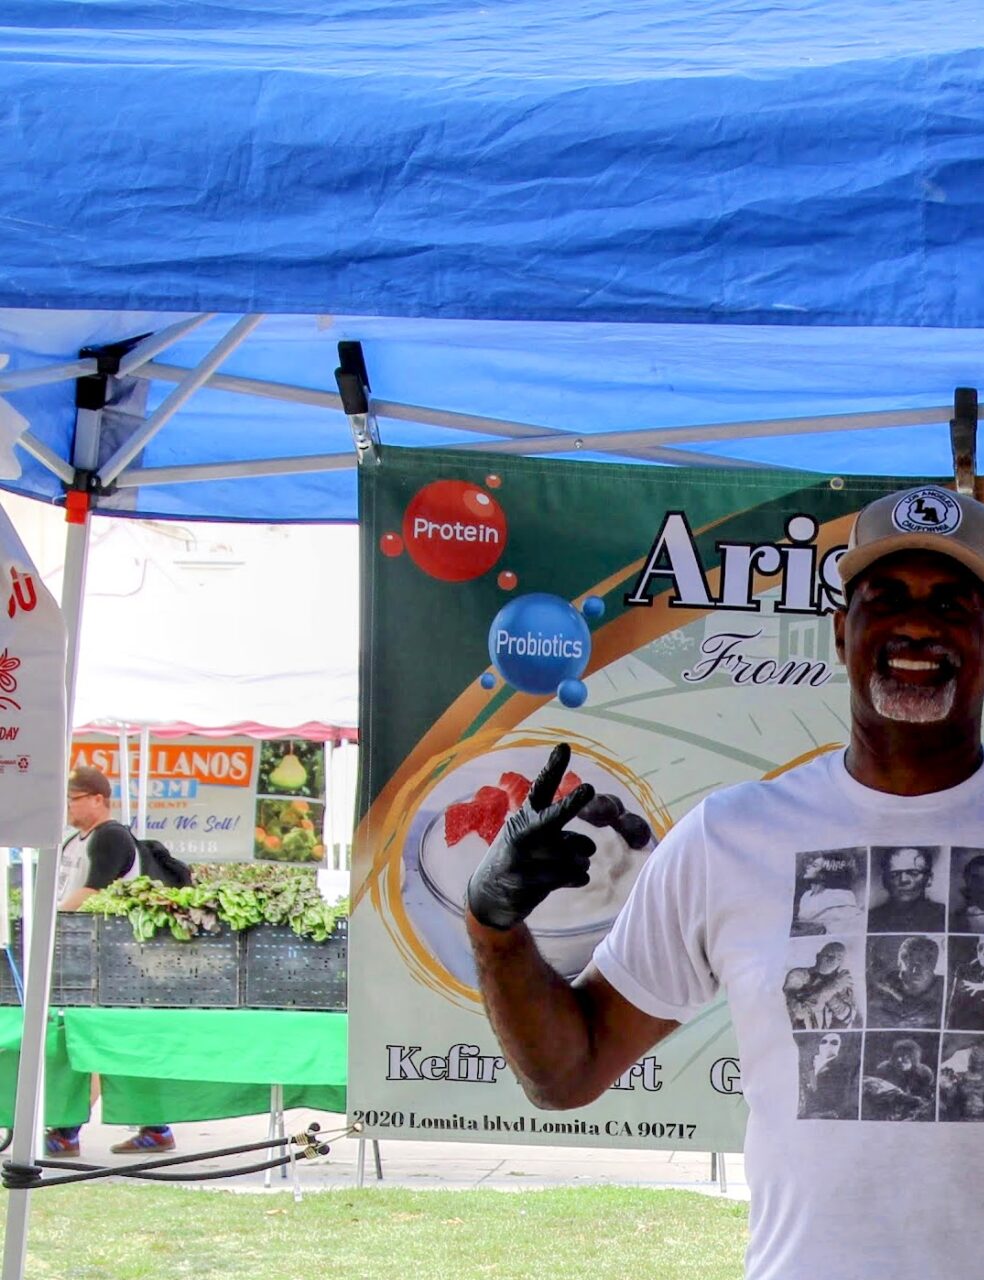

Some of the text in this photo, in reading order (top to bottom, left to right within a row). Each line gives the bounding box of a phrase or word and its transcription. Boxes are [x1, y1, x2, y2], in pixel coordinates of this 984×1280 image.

[903, 490, 955, 508] LOS ANGELES
[412, 517, 500, 544] Protein
[901, 520, 950, 532] CALIFORNIA
[496, 629, 583, 659] Probiotics
[682, 628, 832, 687] From
[174, 814, 198, 830] We
[386, 1043, 508, 1083] Kefir
[353, 1109, 697, 1141] 2020 Lomita blvd Lomita CA 90717
